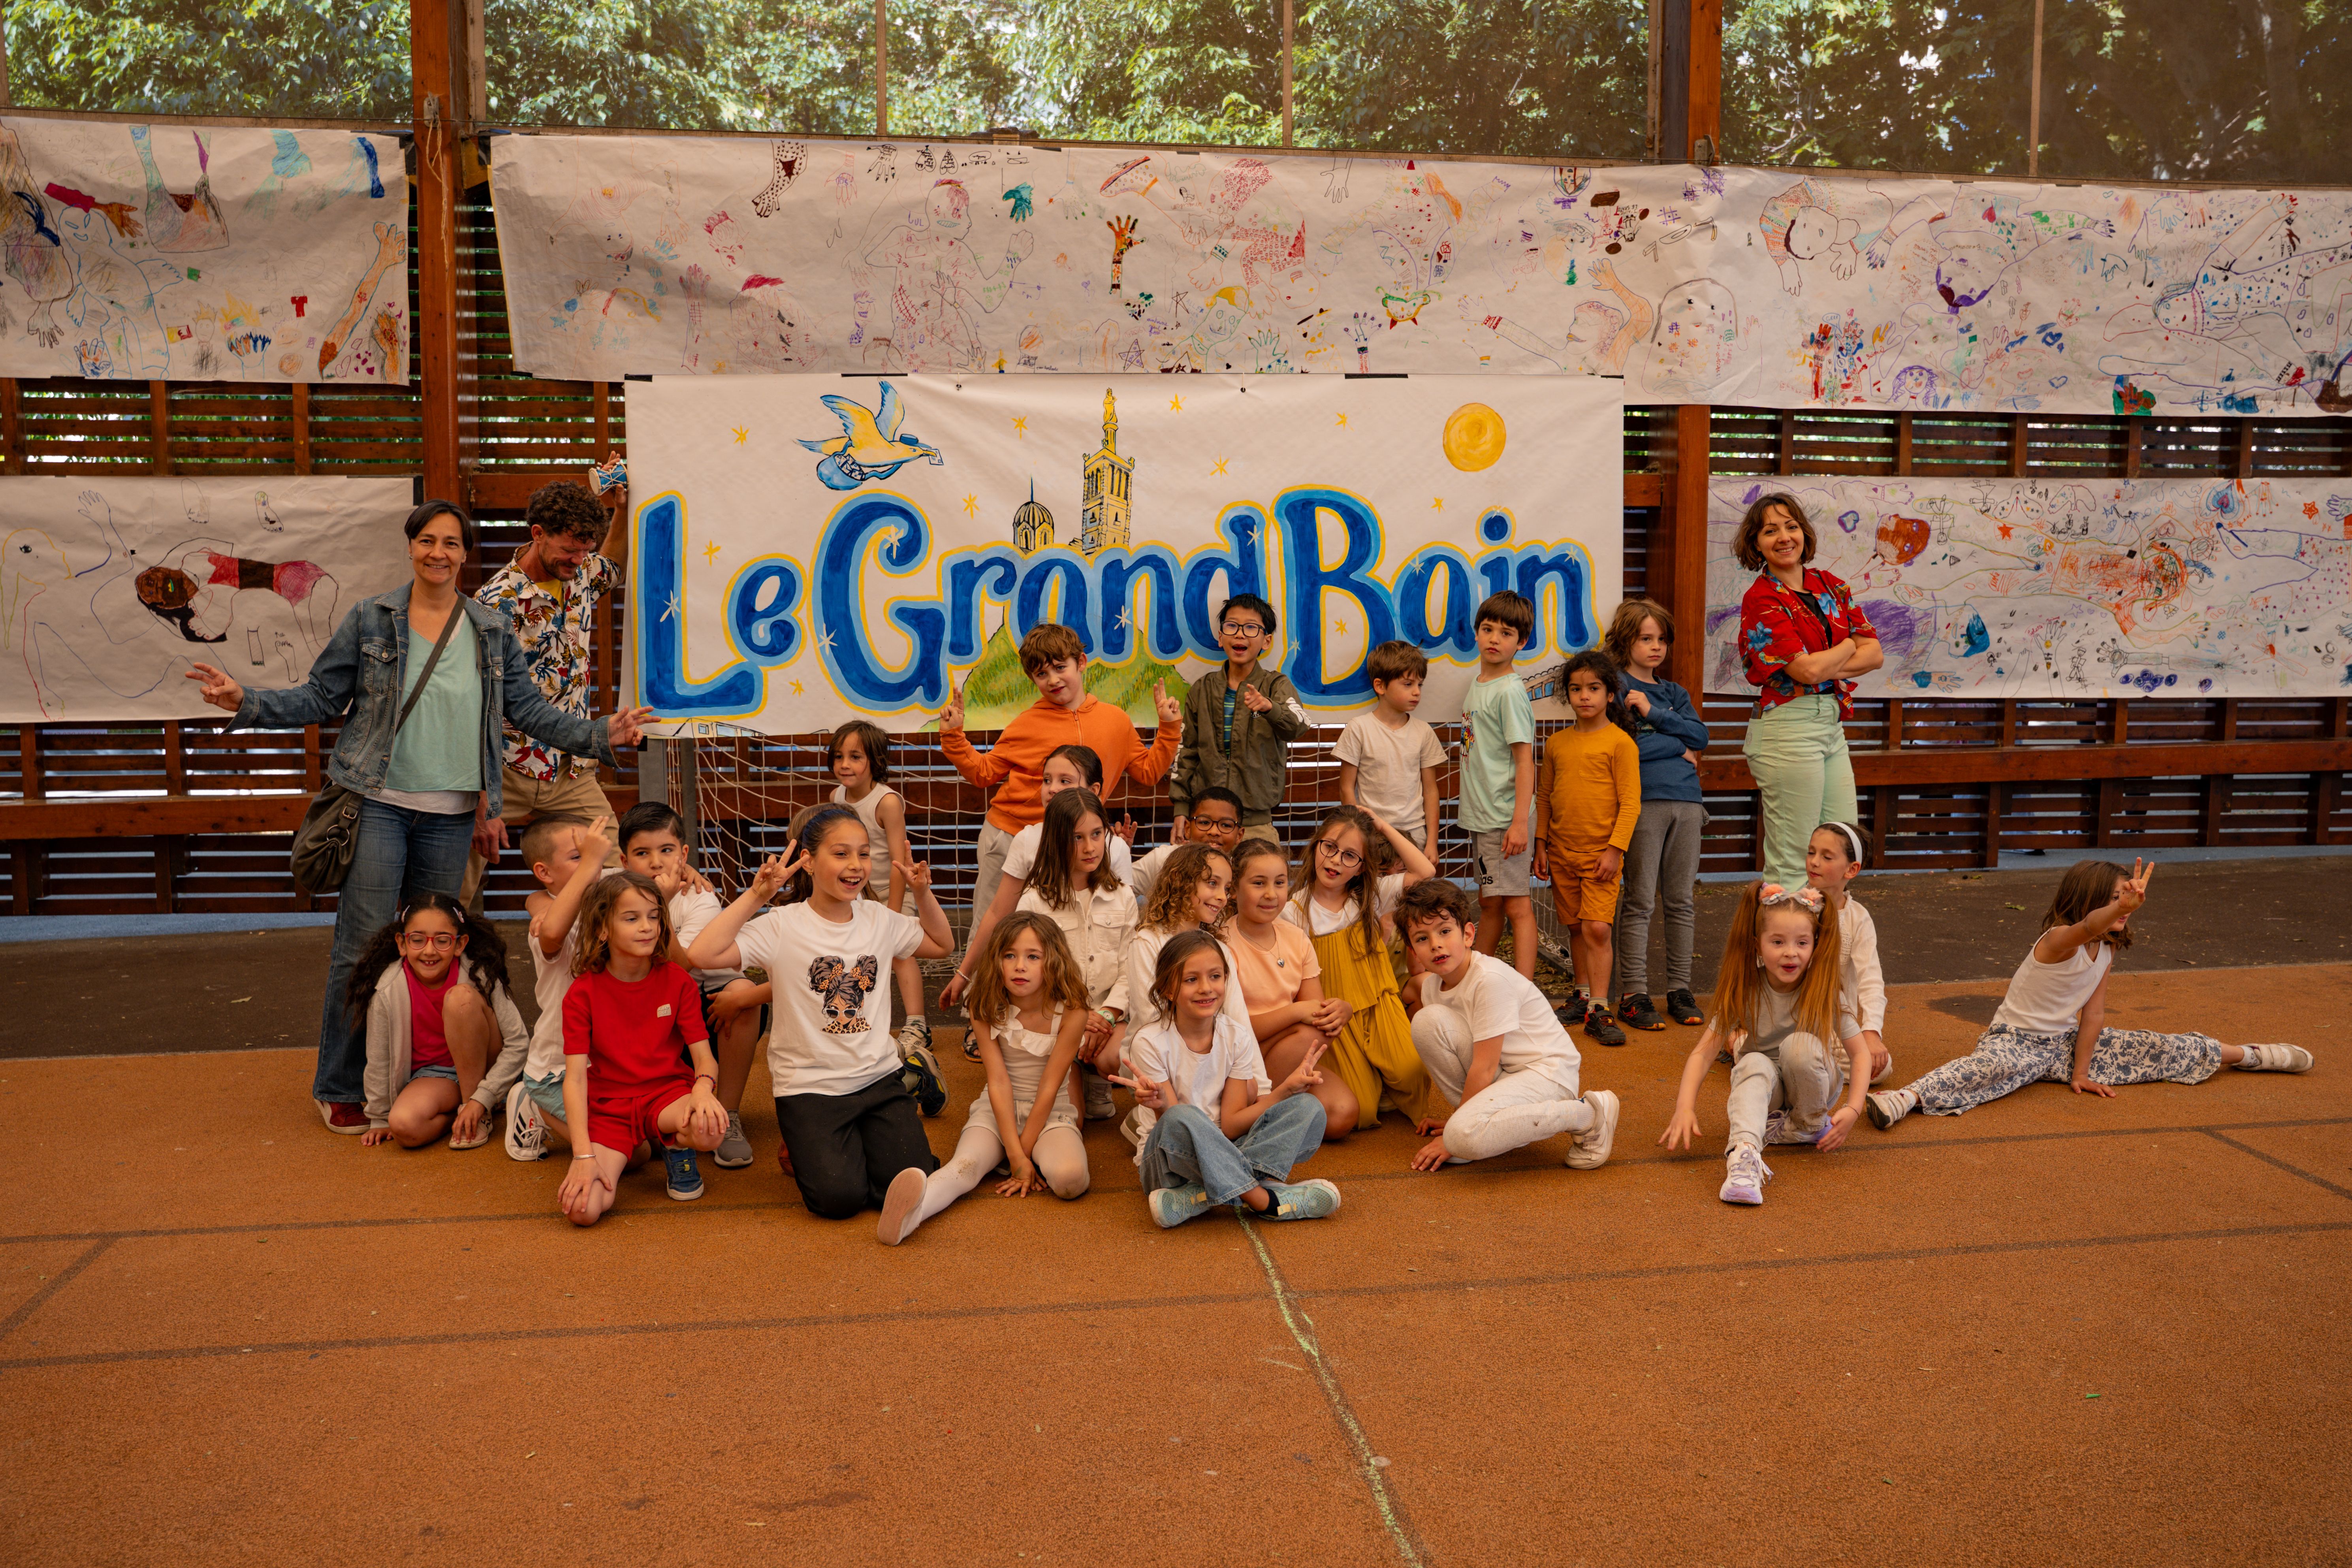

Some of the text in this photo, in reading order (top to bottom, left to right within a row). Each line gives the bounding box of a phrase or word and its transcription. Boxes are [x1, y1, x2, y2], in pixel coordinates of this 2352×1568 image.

[639, 491, 1598, 717] Le Grand Bain
